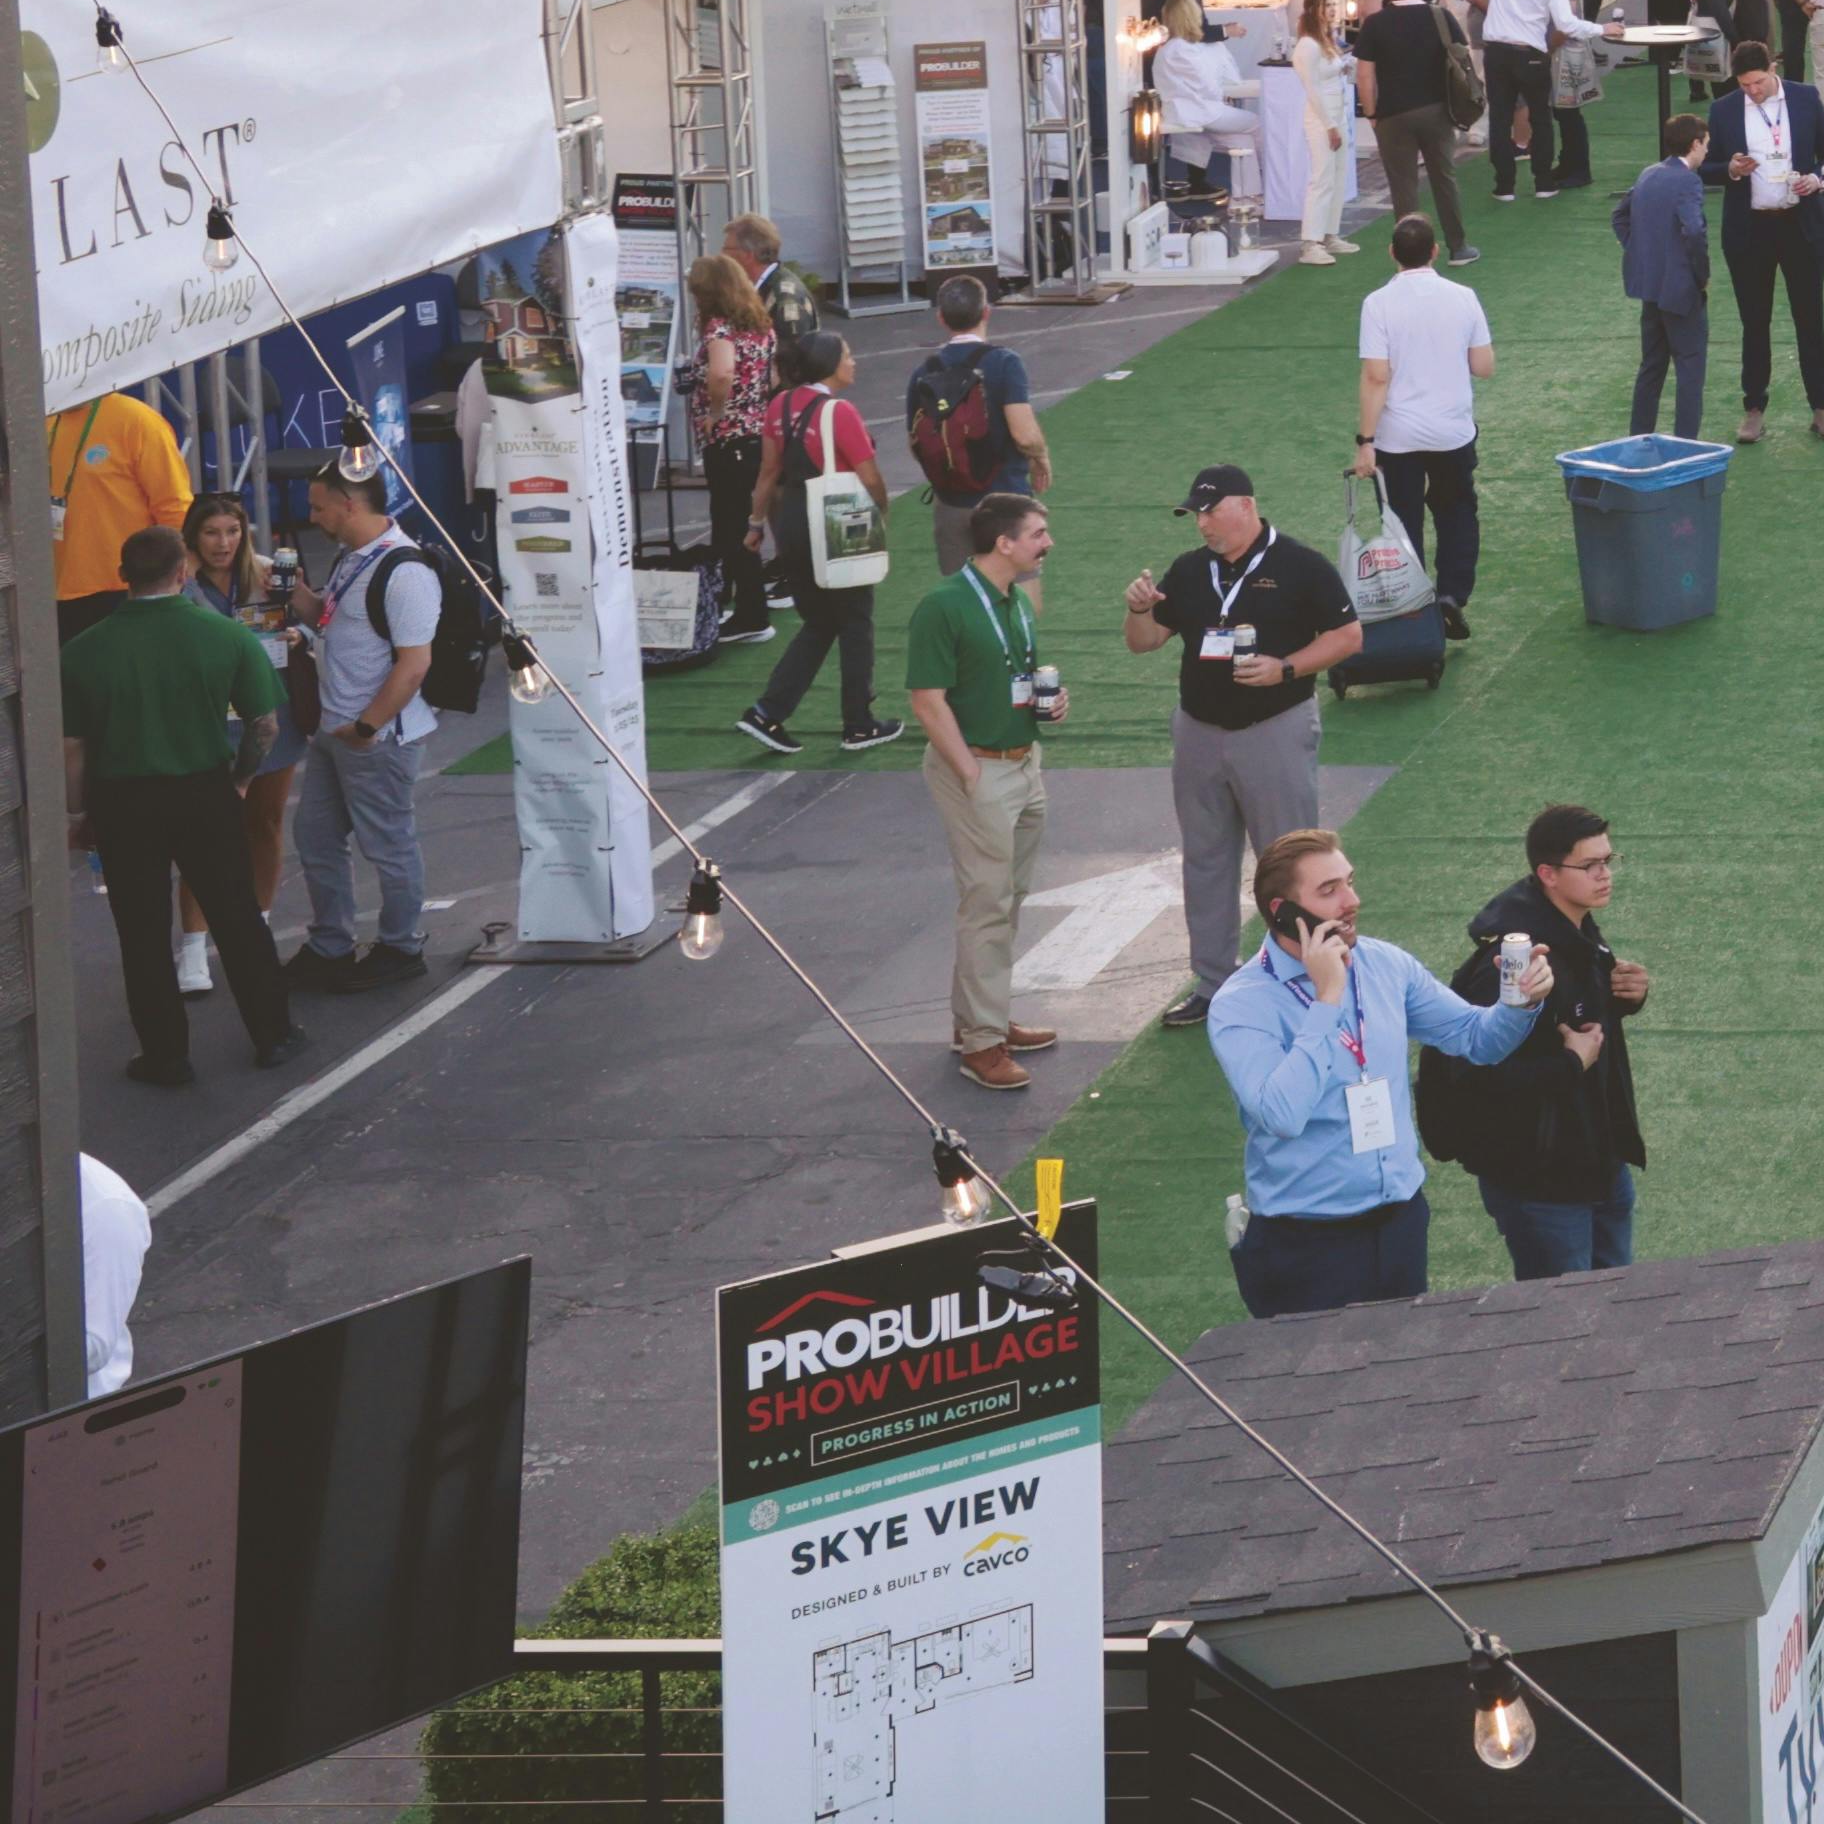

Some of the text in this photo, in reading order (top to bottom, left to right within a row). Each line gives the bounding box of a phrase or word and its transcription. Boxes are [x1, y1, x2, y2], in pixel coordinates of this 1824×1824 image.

[920, 61, 981, 73] PROBUILDER
[171, 272, 257, 334] Siding
[496, 440, 579, 455] ADVANTAGE
[747, 1316, 1080, 1433] SHOW VILLAGE
[820, 1392, 1011, 1455] PROGRESS IN ACTION
[785, 1426, 1081, 1514] SCAN TO SEE IN-DEPTH INFORMATION ABOUT THE HOMES AND PRODUCTS
[791, 1476, 1041, 1576] SKYE VIEW
[791, 1562, 951, 1620] DESIGNED & BUILT BY
